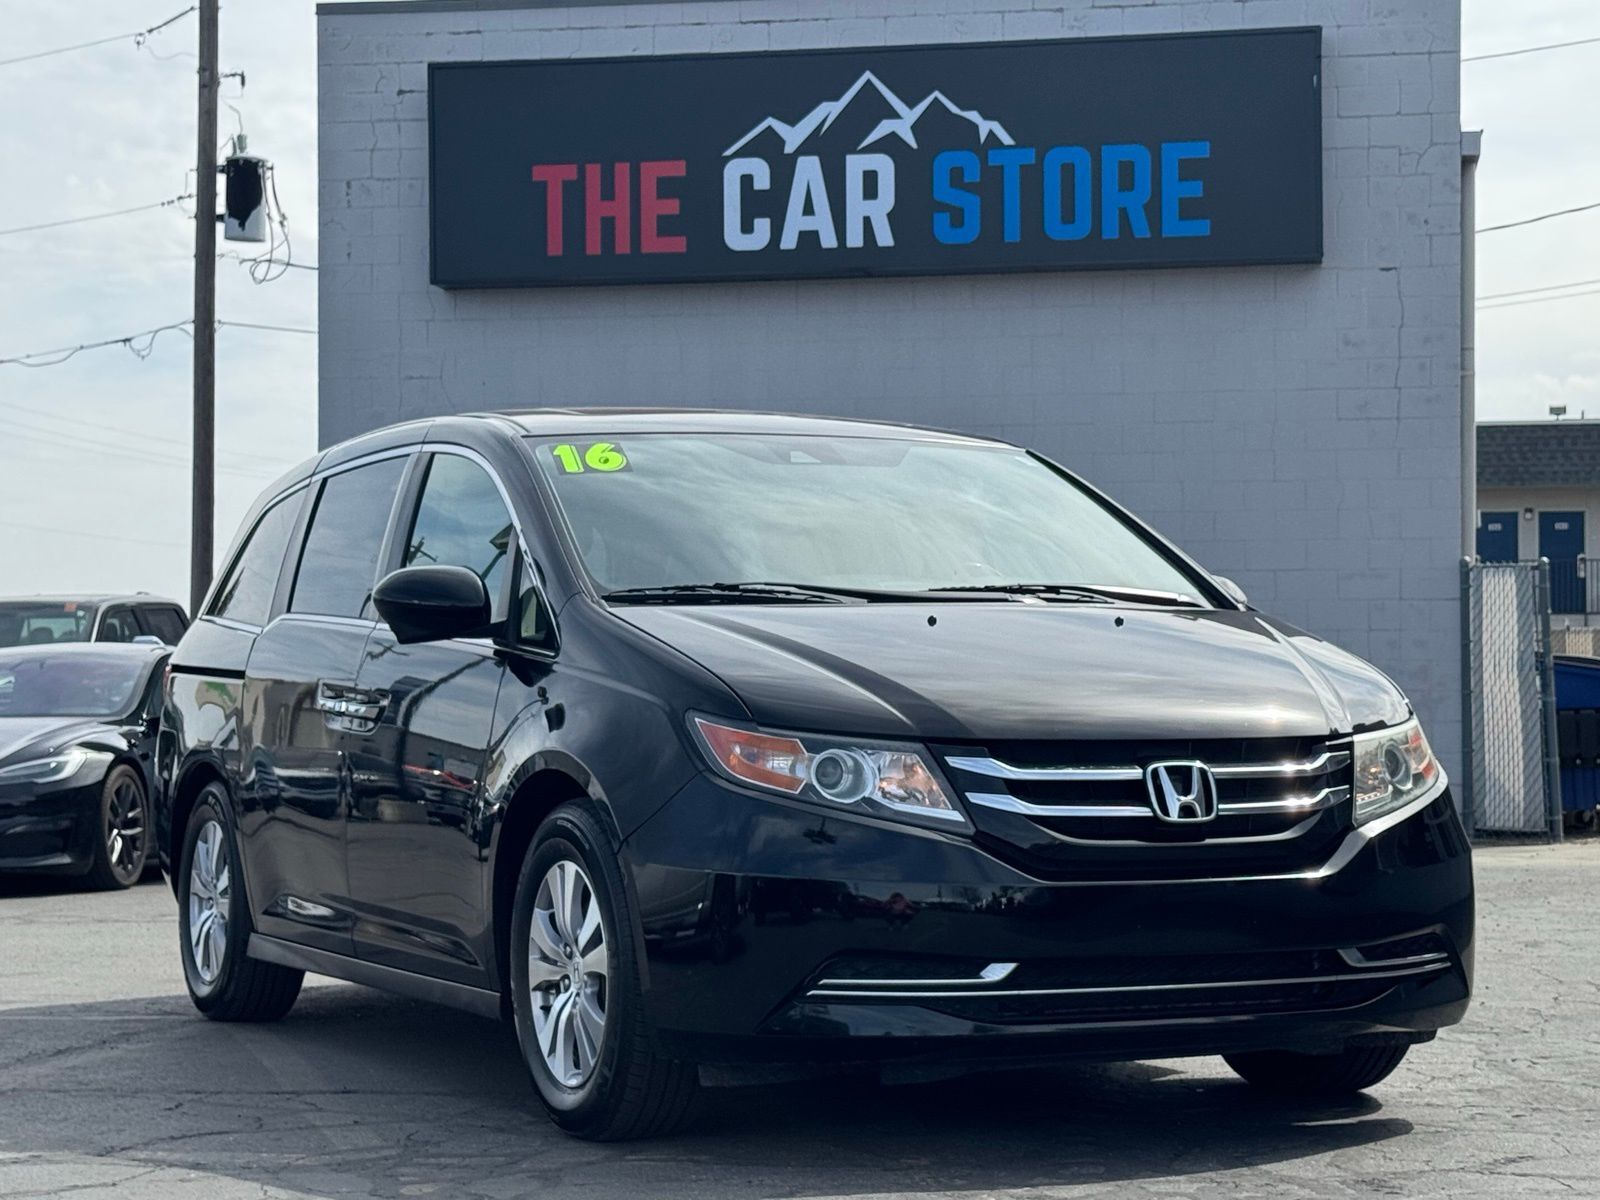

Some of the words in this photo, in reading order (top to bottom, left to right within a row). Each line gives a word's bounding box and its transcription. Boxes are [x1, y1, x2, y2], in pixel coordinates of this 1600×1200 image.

[533, 160, 686, 256] THE
[723, 154, 895, 251] CAR
[932, 141, 1211, 245] STORE
[553, 442, 627, 473] 16
